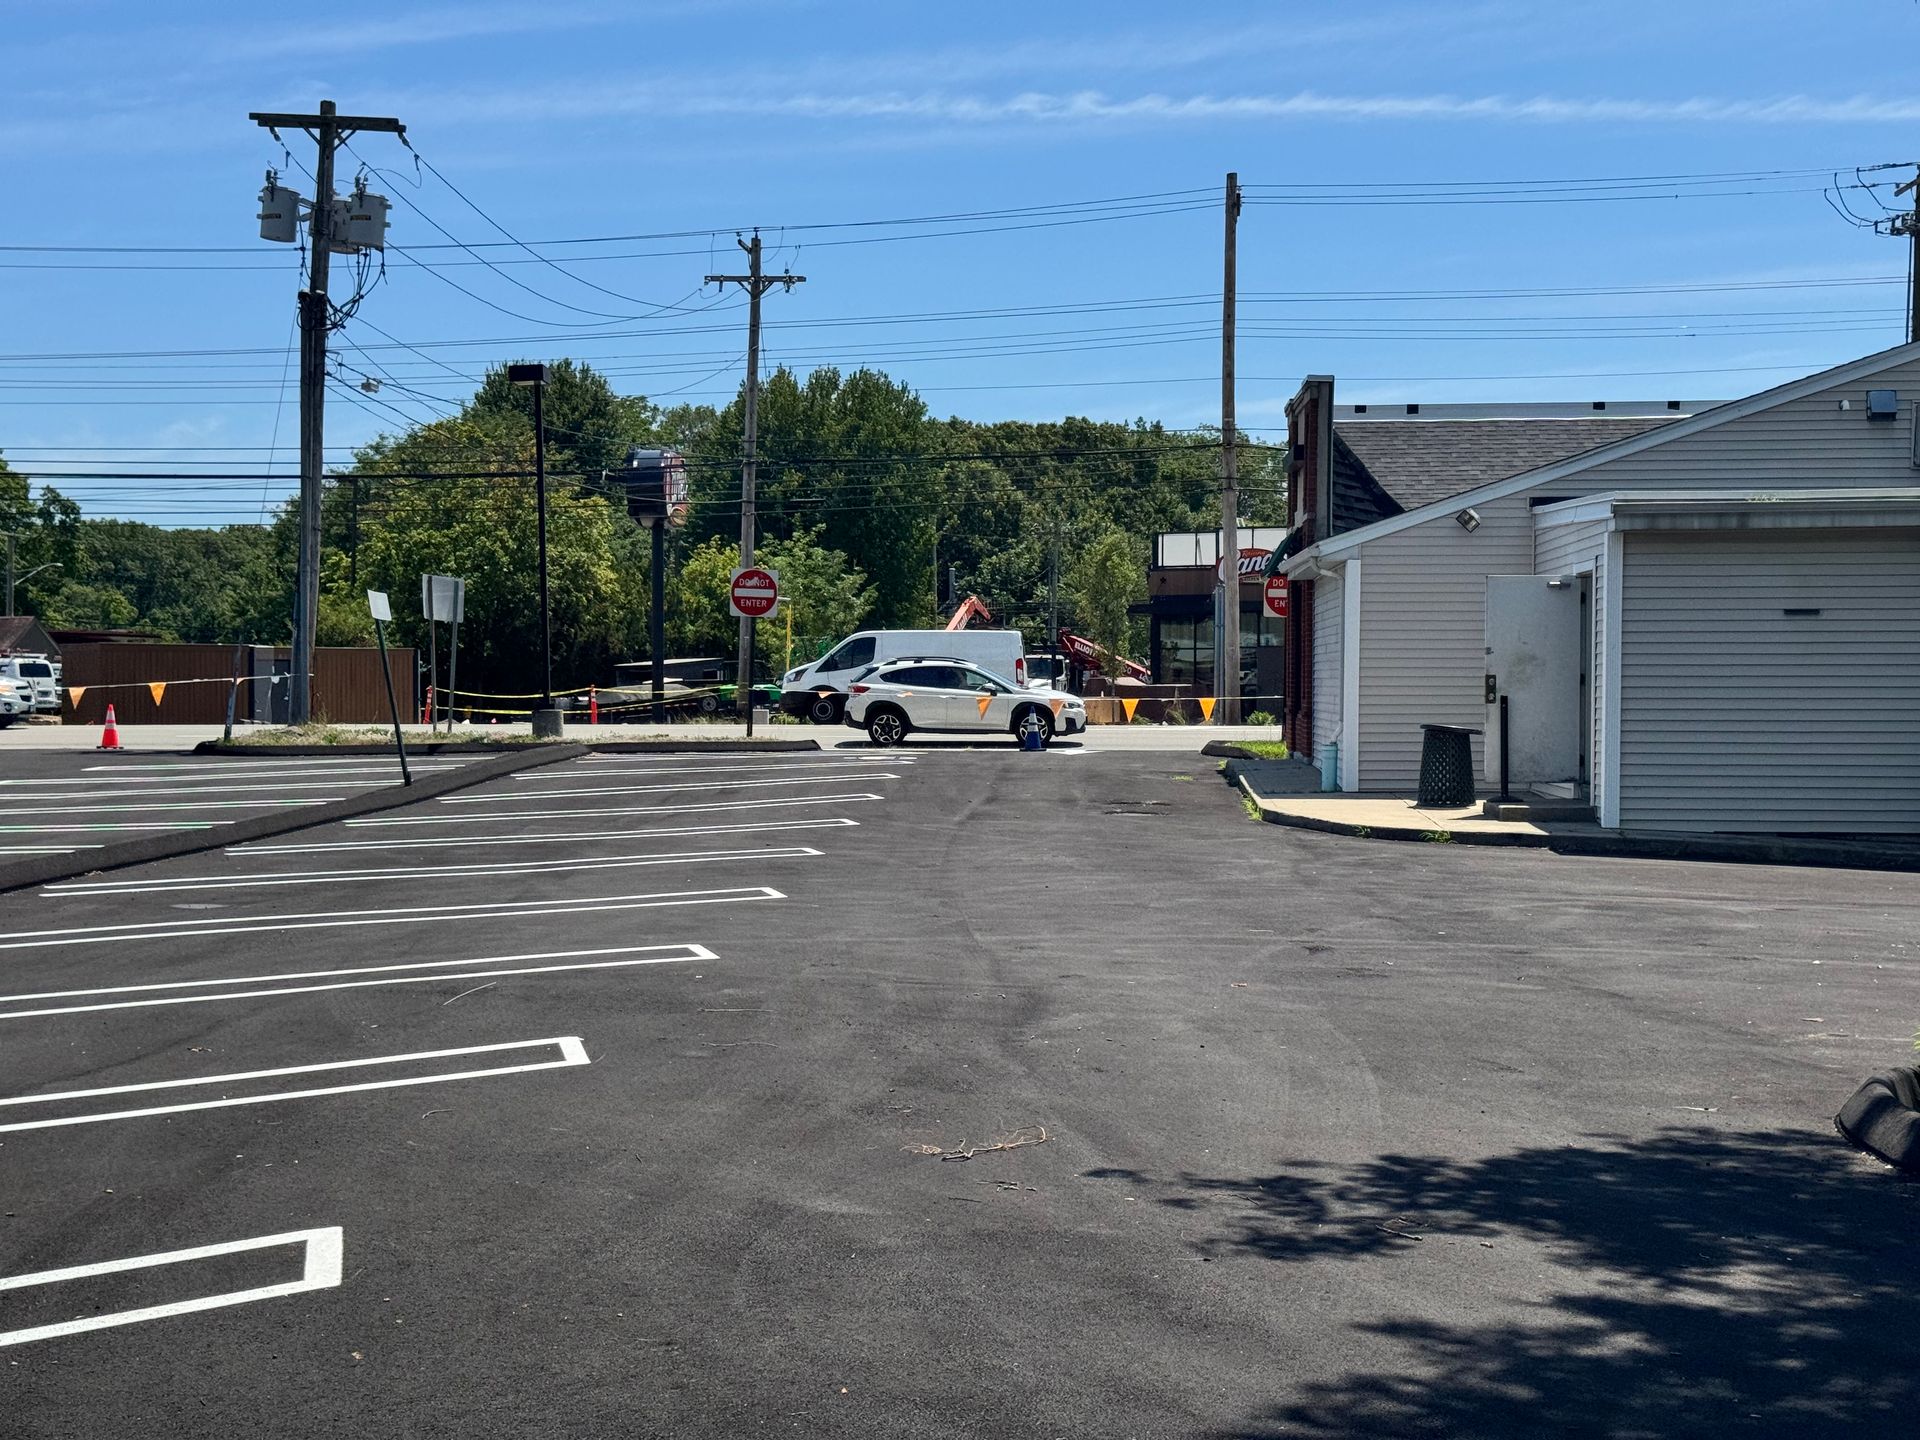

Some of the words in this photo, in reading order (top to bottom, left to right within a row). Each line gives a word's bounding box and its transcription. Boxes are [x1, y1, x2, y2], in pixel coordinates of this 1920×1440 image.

[739, 579, 751, 587] DO
[753, 579, 770, 587] NOT
[1272, 579, 1284, 587] DO
[740, 599, 767, 607] ENTER
